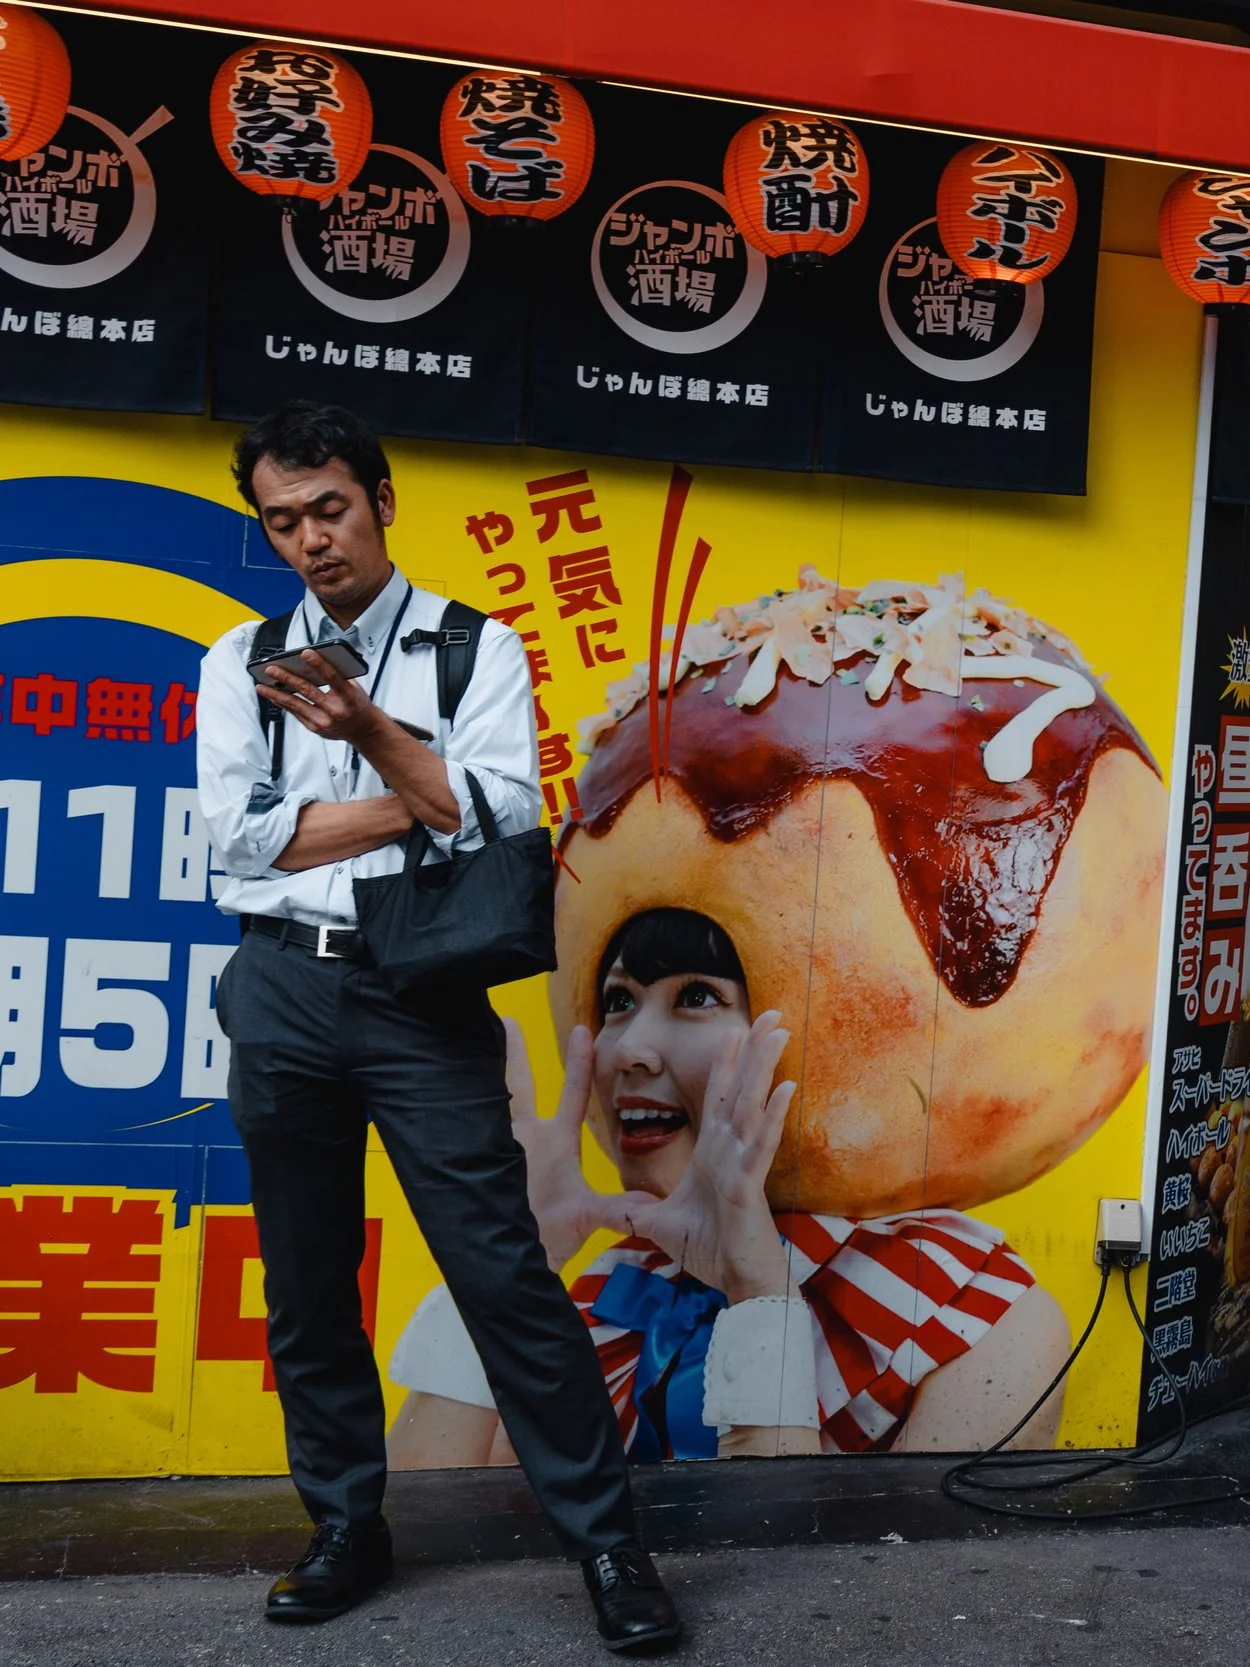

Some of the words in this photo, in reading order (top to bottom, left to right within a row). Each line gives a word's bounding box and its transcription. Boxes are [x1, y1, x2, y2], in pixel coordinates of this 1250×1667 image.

[458, 75, 565, 203] 焼そば
[759, 118, 861, 237] 焼酎
[0, 192, 99, 246] 酒場
[608, 211, 741, 260] ジャンボ
[319, 230, 416, 281] 酒場
[627, 264, 717, 313] 酒場
[911, 294, 997, 343] 酒場
[525, 468, 626, 669] 元気に
[1171, 1045, 1202, 1075] アサヒ
[1165, 1116, 1232, 1164] ハイボール
[1159, 1216, 1211, 1262] いいちこ
[1154, 1267, 1197, 1313] 二階堂
